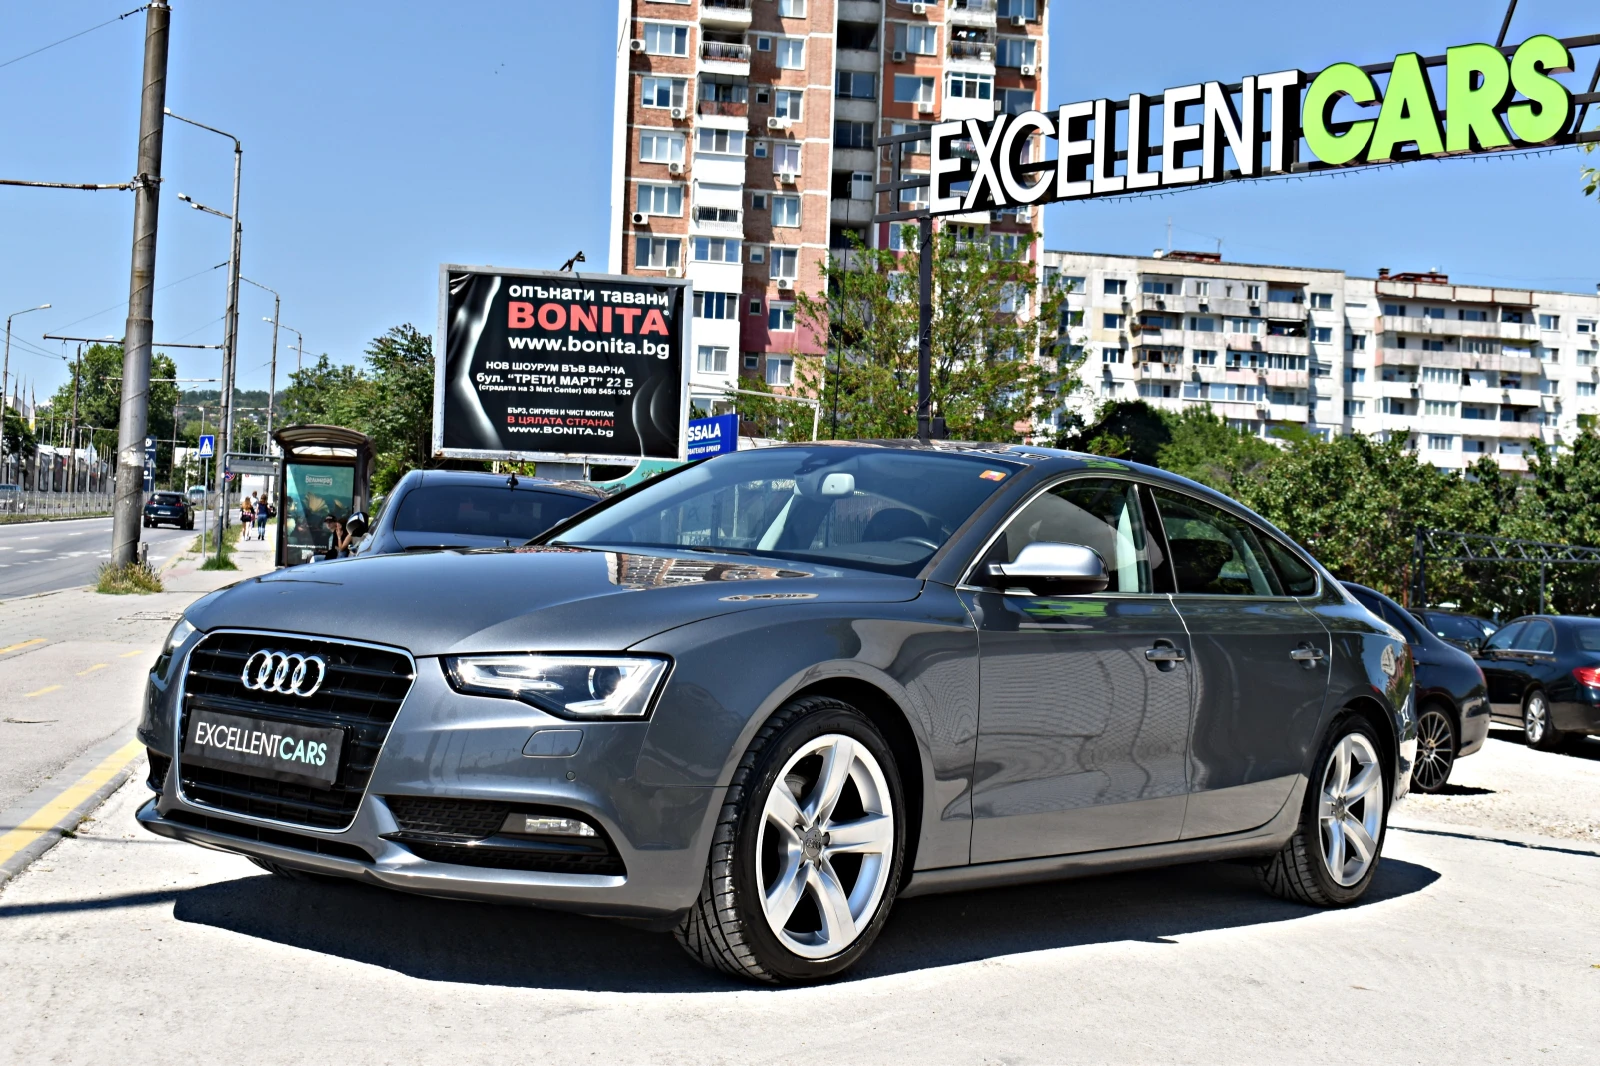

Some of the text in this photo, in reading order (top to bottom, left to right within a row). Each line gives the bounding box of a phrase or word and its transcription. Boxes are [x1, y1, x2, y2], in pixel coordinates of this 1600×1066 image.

[508, 284, 669, 307] опънати тавани
[508, 301, 669, 336] BONITA
[508, 335, 670, 360] www.bonita.bg
[485, 361, 626, 375] НОВ ШОУРУМ ВЪВ ВАРНА
[476, 373, 504, 385] бул.
[606, 377, 621, 388] 22
[624, 378, 634, 388] Б
[478, 383, 517, 392] (сградата
[535, 385, 552, 393] Mart
[553, 386, 582, 395] Center)
[583, 387, 597, 395] 089
[617, 388, 631, 396] 934
[507, 407, 615, 418] БЪРЗ, СИГУРЕН И ЧИСТ МОНТАЖ
[507, 415, 615, 427] В ЦЯЛАТА СТРАНА!
[507, 426, 614, 438] www.BONITA.bg
